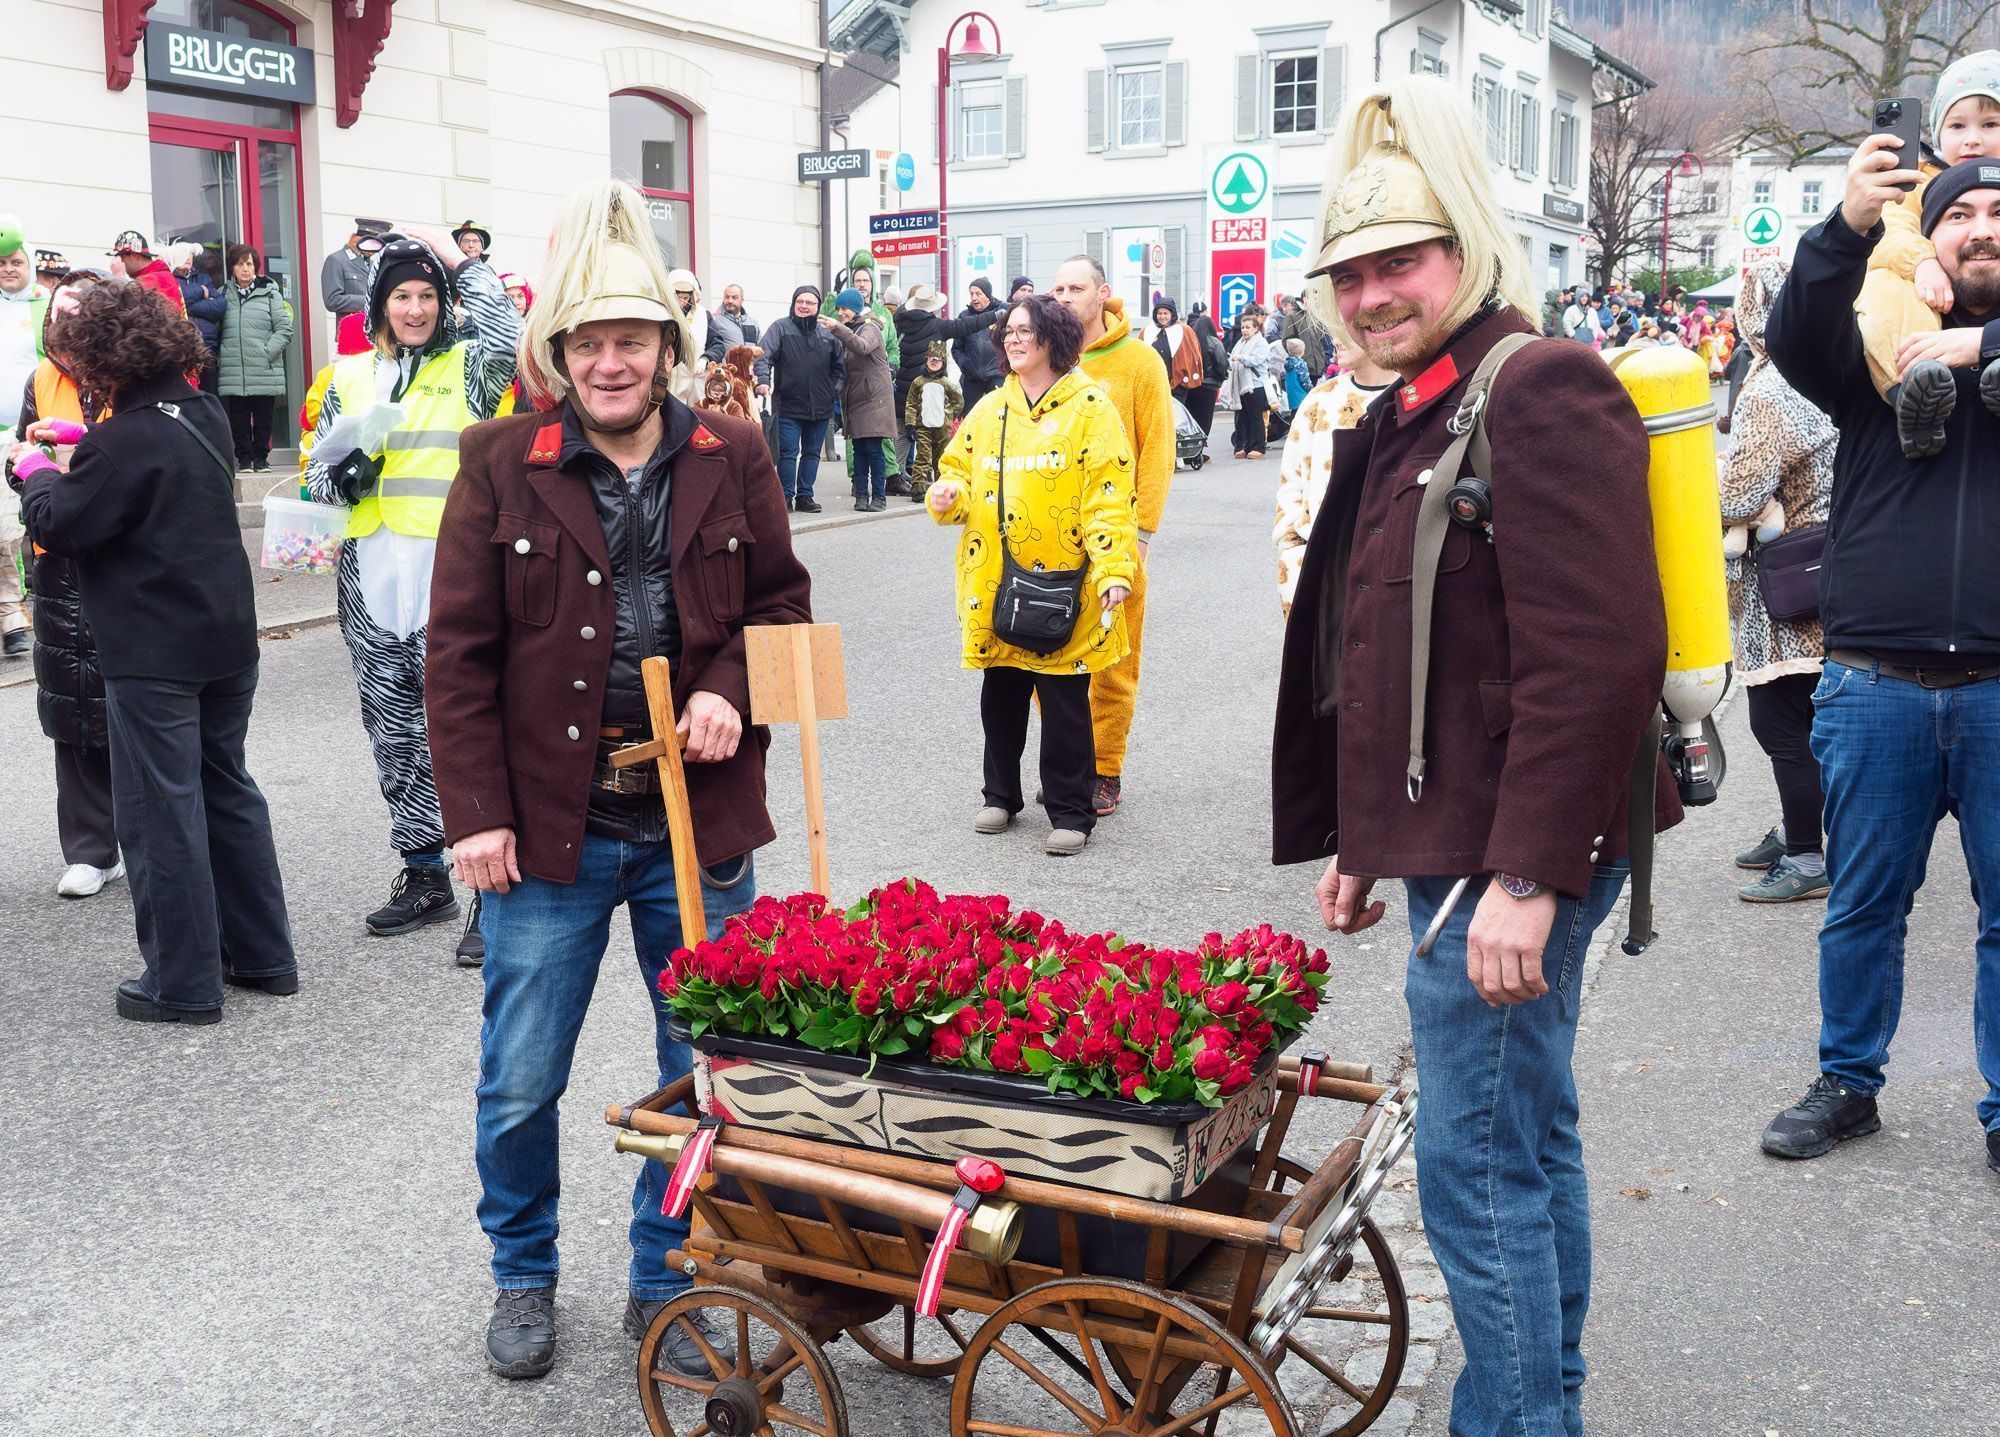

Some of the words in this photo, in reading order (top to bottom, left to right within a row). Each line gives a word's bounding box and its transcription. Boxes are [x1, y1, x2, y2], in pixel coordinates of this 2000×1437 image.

[168, 32, 297, 86] BRUGGER
[803, 154, 861, 174] BRUGGER
[883, 216, 927, 229] POLIZEI
[1215, 218, 1264, 231] EURO
[1215, 229, 1264, 242] SPAR
[885, 243, 895, 252] Am
[898, 240, 930, 251] Garnmarkt
[1229, 288, 1248, 314] P
